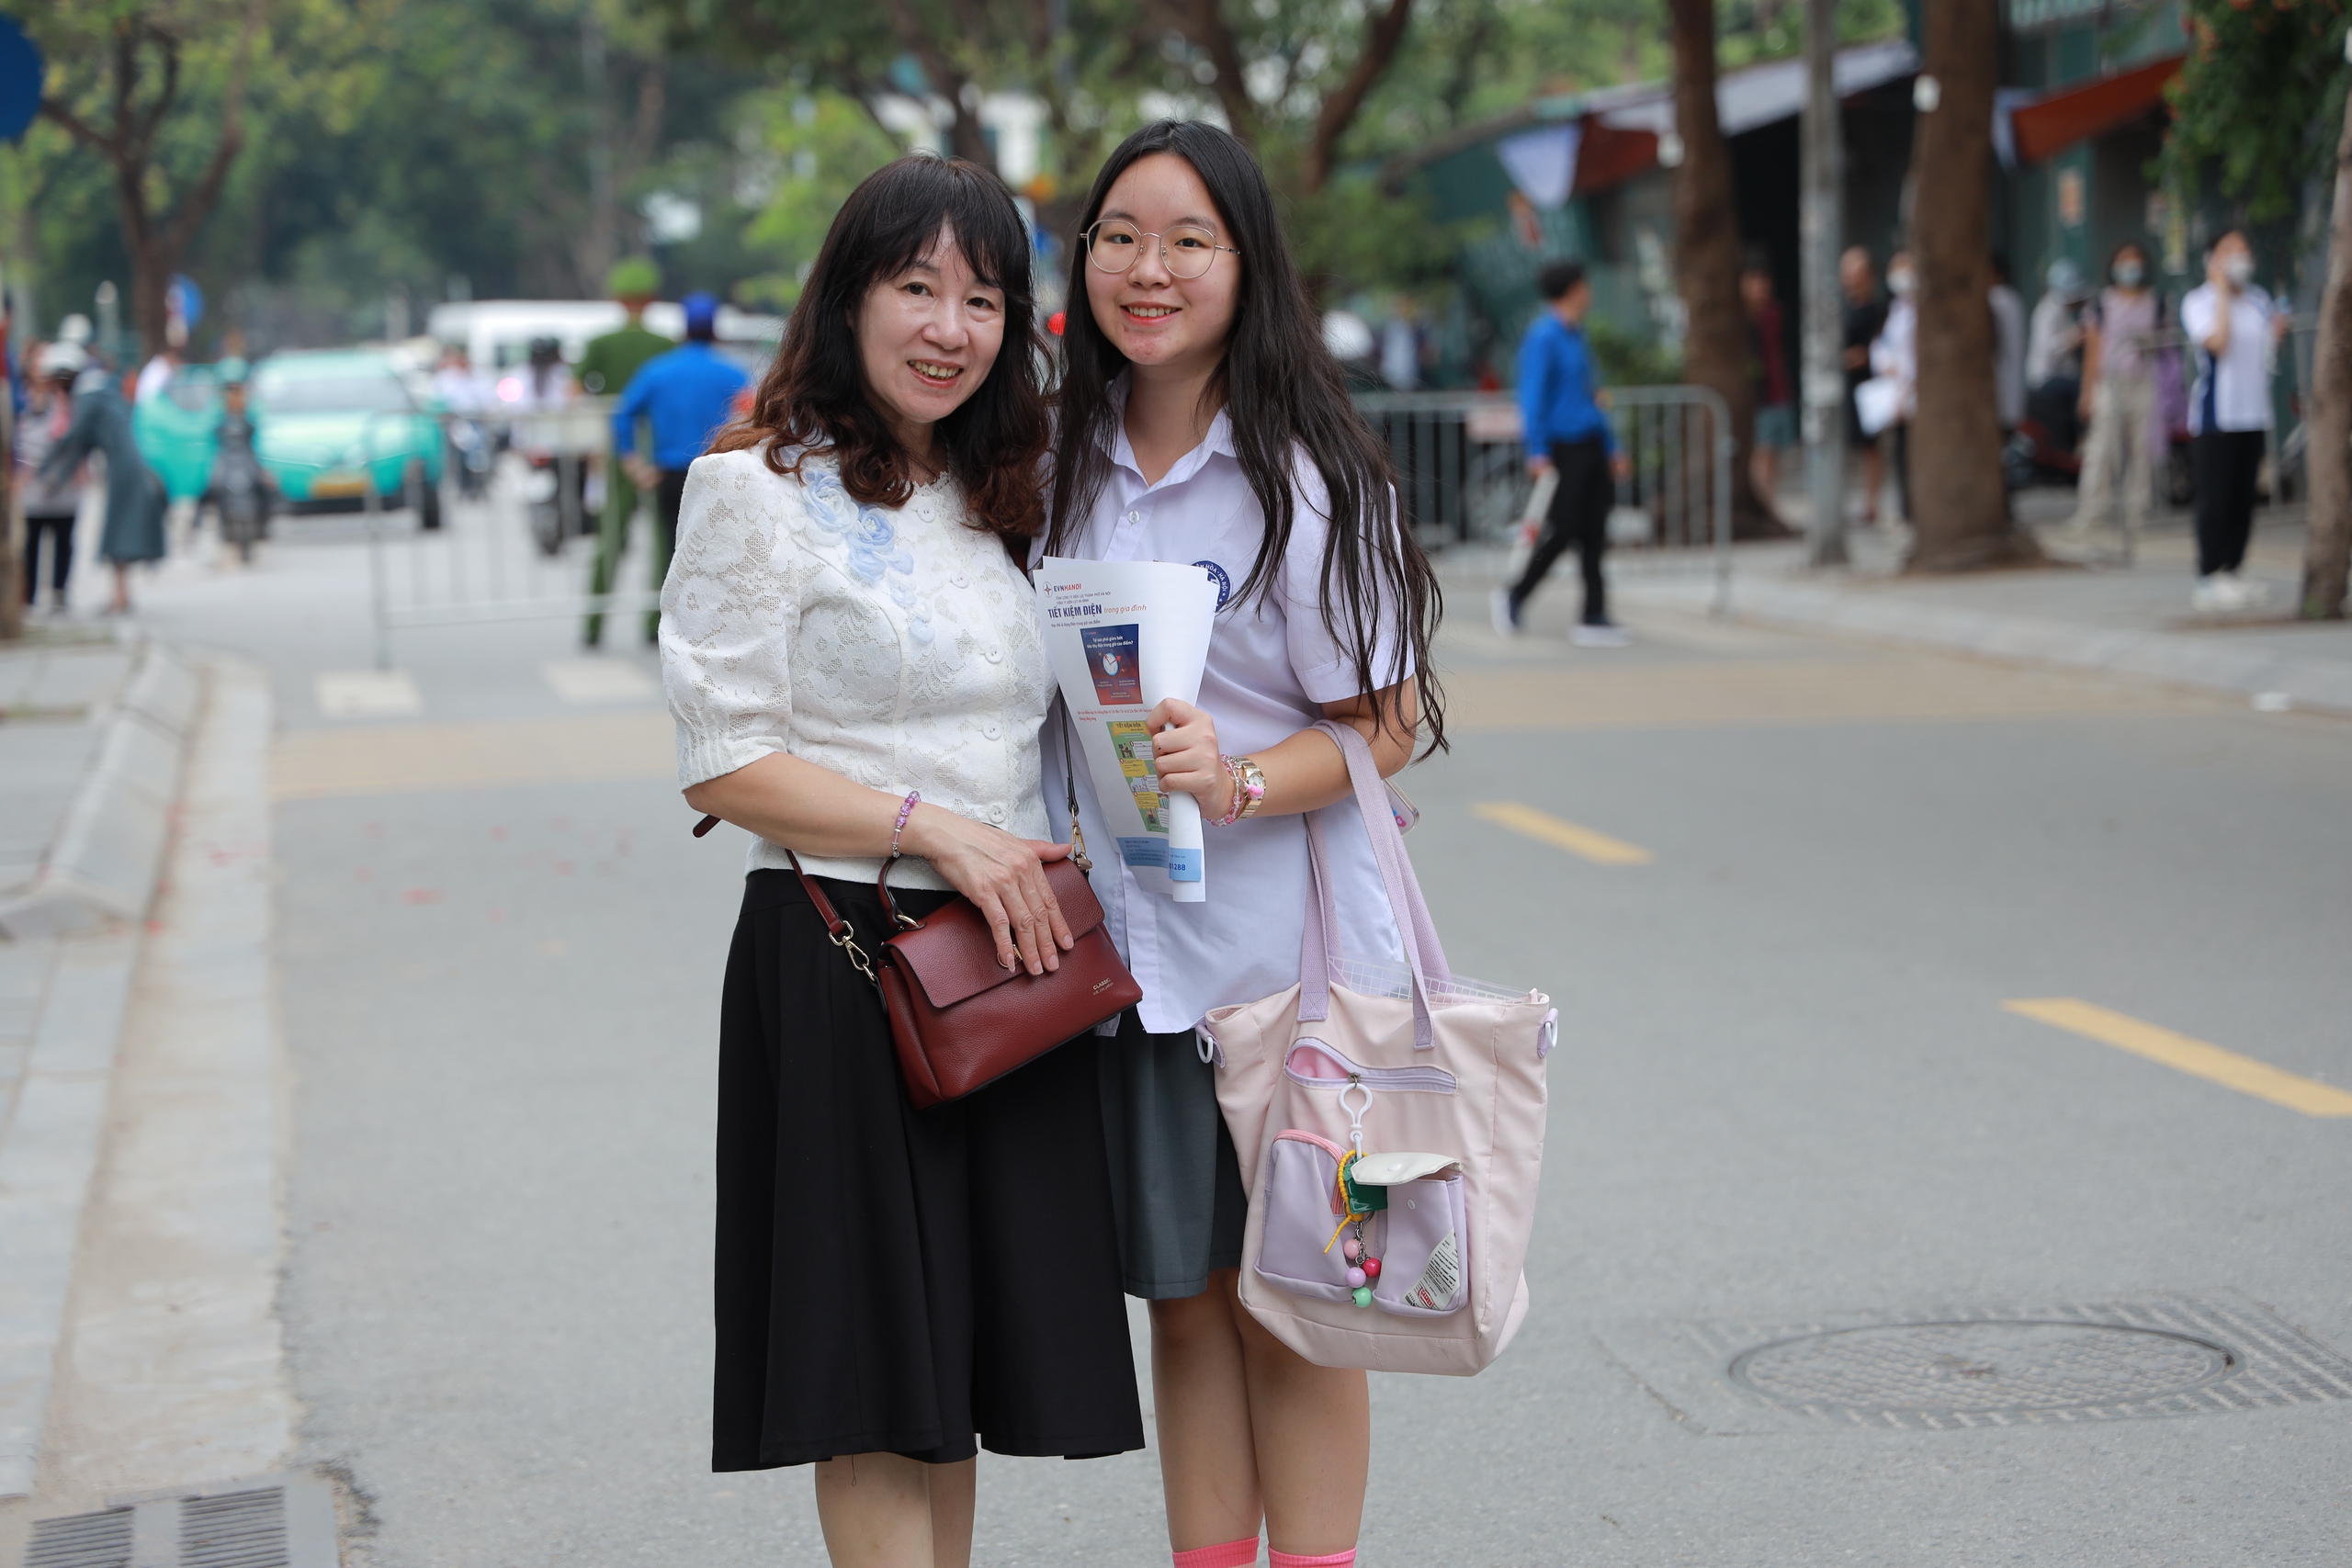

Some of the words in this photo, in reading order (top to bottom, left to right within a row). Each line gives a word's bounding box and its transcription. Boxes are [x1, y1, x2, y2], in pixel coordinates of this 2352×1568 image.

[1054, 583, 1081, 592] EVNHANOI
[1047, 605, 1062, 618] TIẾT
[1064, 605, 1081, 619] KIỆM
[1083, 604, 1102, 617] ĐIỆN
[1120, 606, 1130, 615] gia
